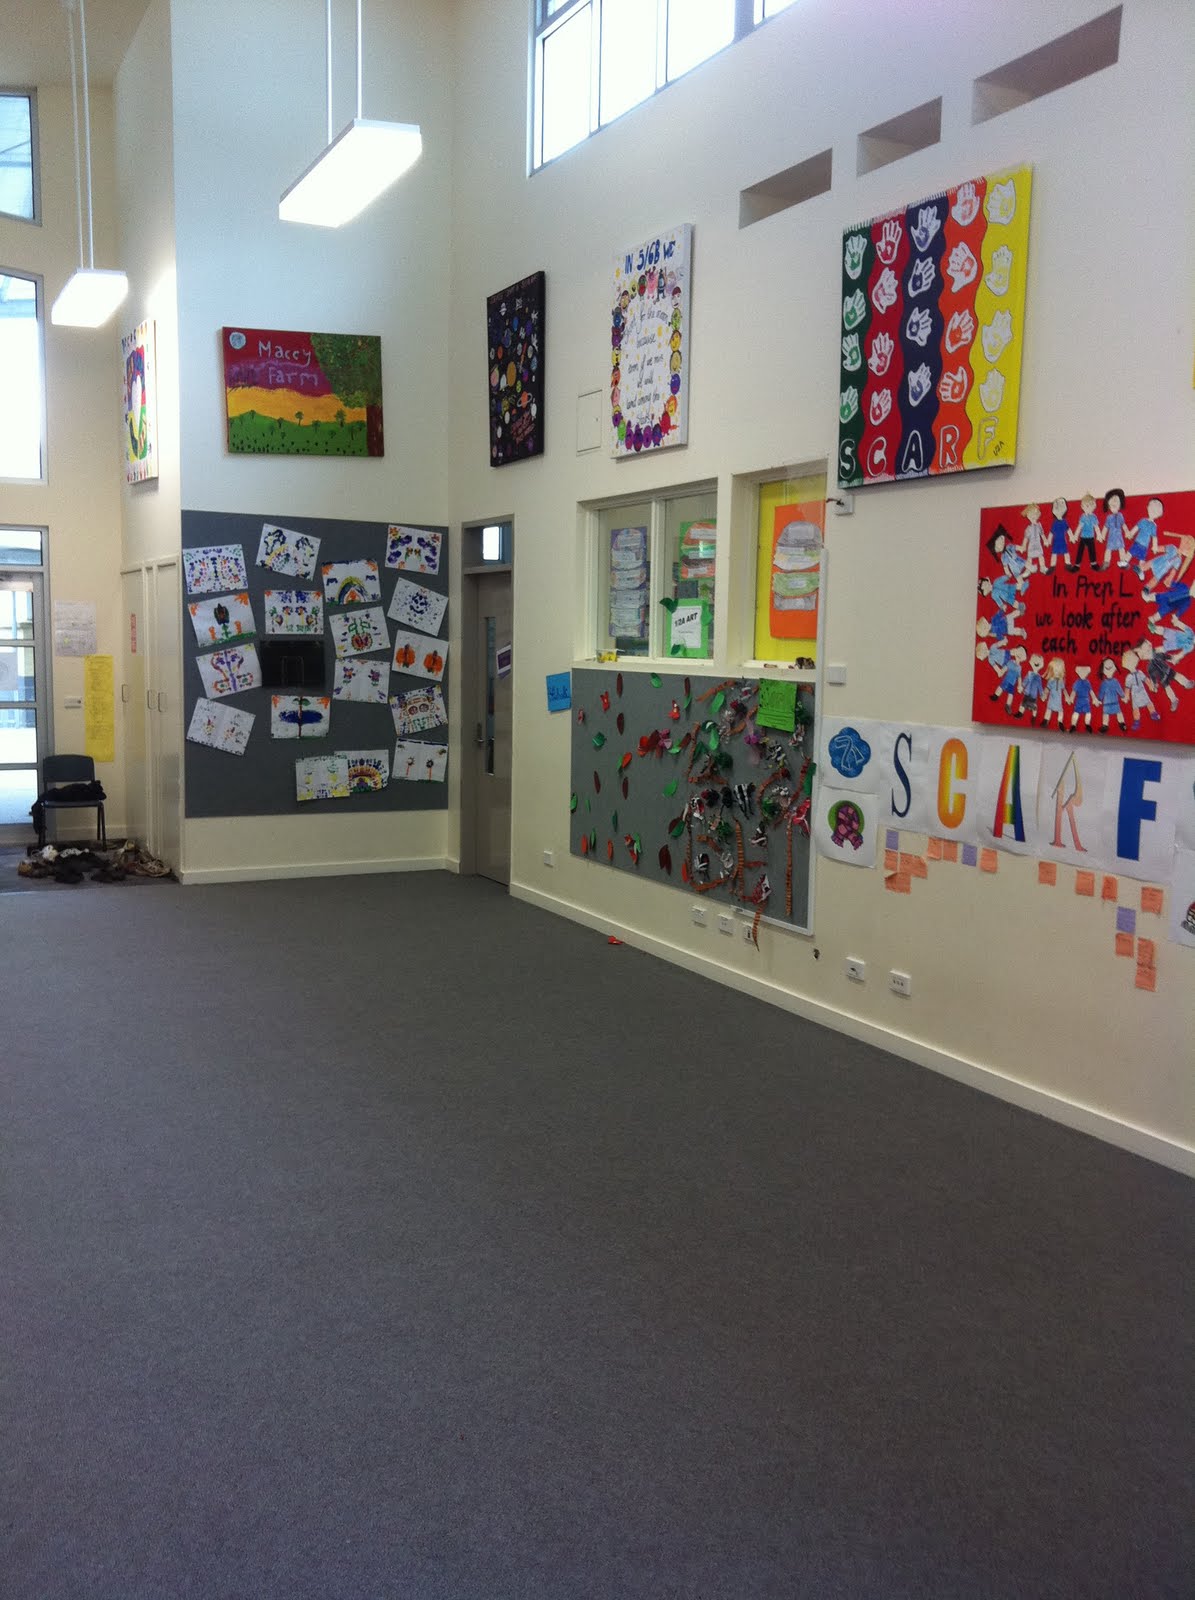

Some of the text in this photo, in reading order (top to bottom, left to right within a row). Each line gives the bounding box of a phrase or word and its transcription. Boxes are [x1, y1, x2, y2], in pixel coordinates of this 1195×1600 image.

[624, 253, 633, 274] IN
[637, 239, 660, 271] 5/6B
[269, 366, 318, 386] Farm
[839, 415, 999, 480] SCARF
[1053, 572, 1134, 605] In Prep L
[1035, 602, 1140, 633] we look after
[1042, 631, 1132, 656] each other
[891, 732, 1162, 861] SCARF
